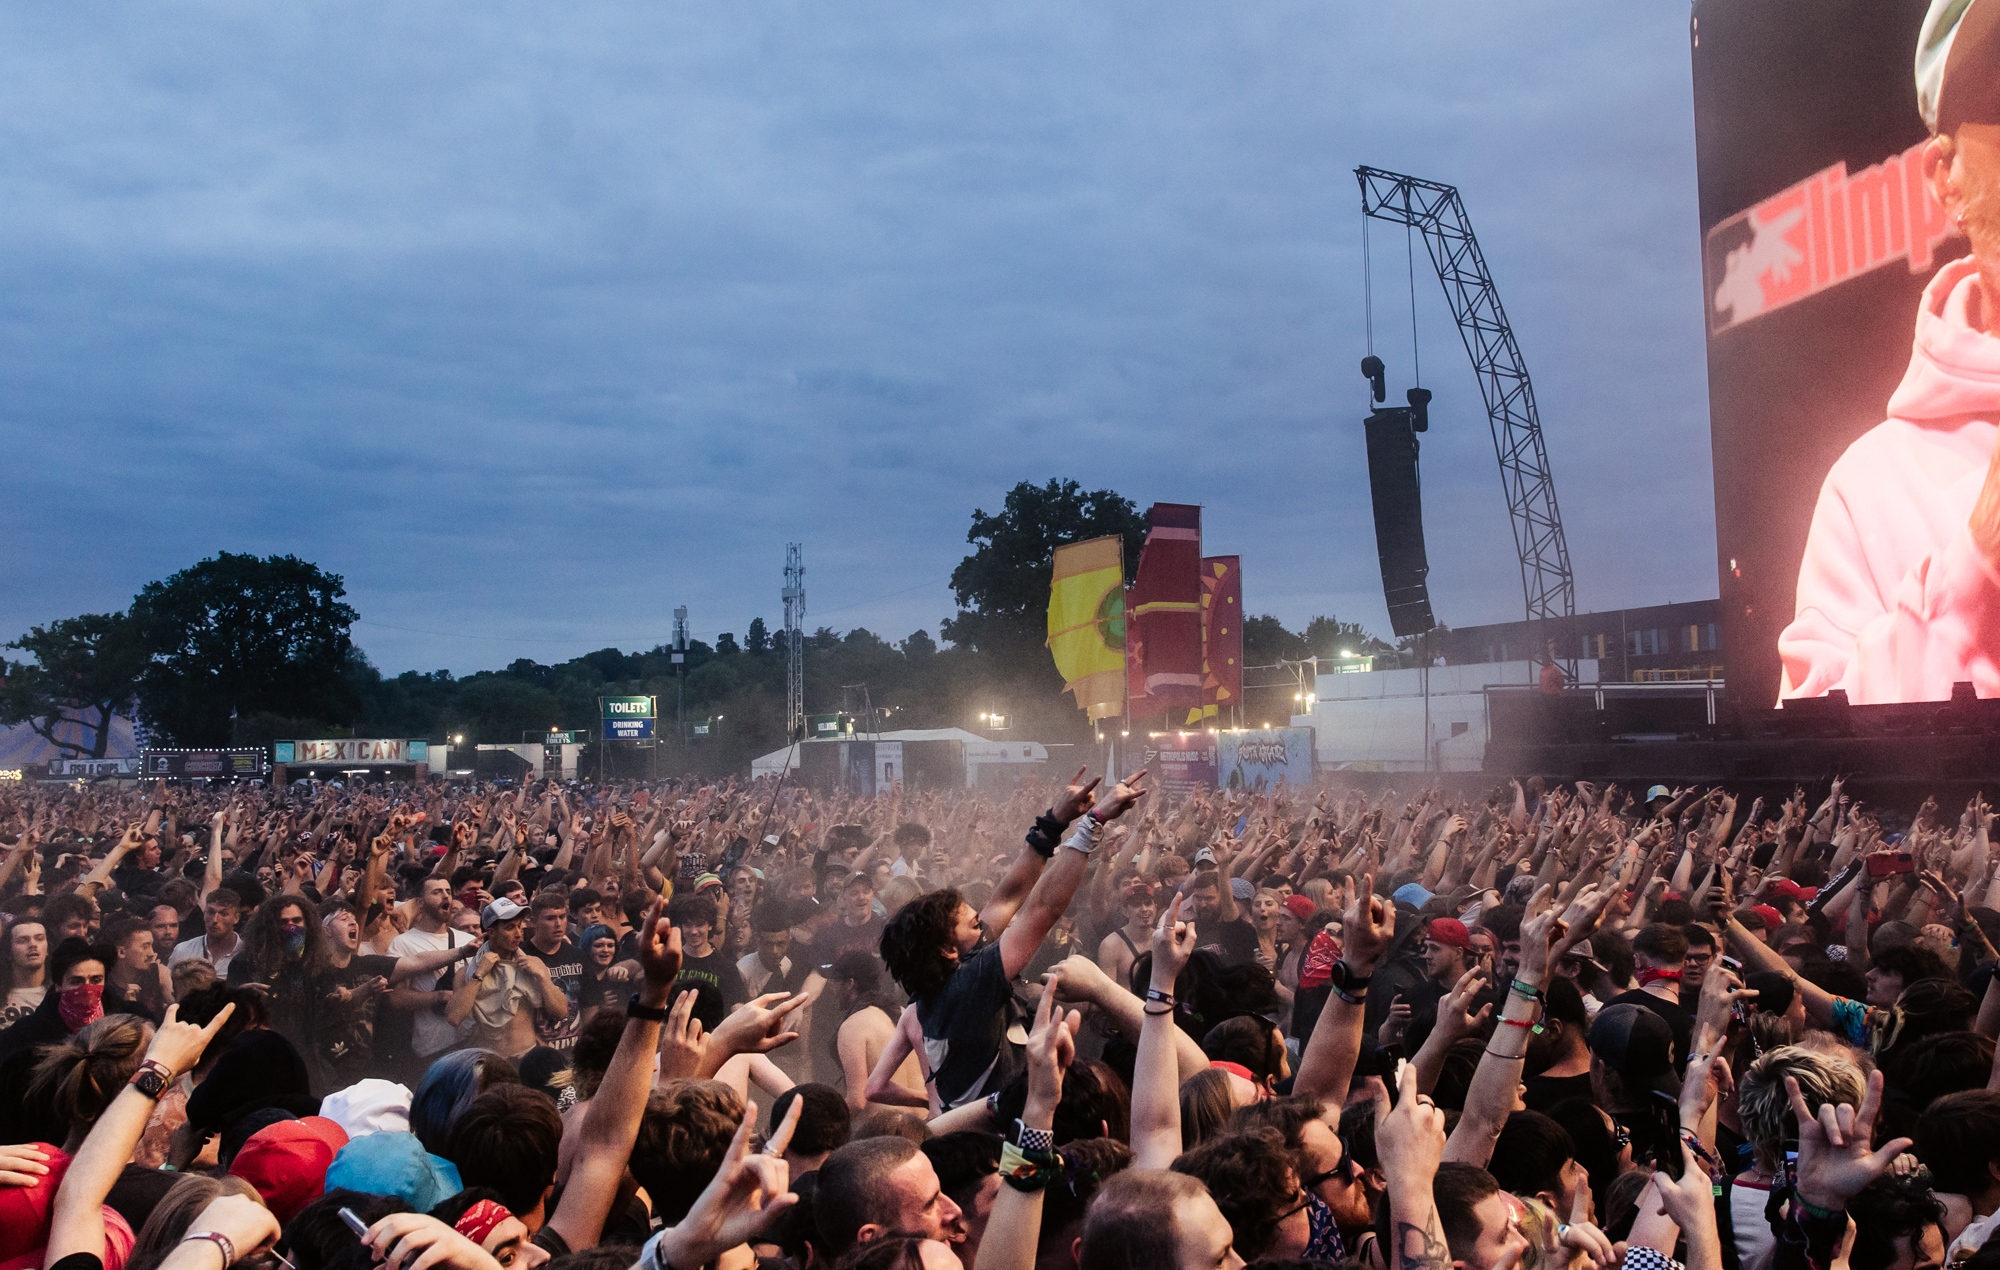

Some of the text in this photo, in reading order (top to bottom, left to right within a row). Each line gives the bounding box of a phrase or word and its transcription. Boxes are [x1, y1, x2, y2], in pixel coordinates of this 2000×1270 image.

[608, 702, 647, 714] TOILETS
[612, 721, 644, 729] DRINKING
[617, 729, 639, 737] WATER
[301, 741, 401, 760] MEXICAN
[1160, 751, 1186, 762] METROPOLIS
[70, 764, 86, 775] FISH
[97, 763, 119, 775] CHIPS
